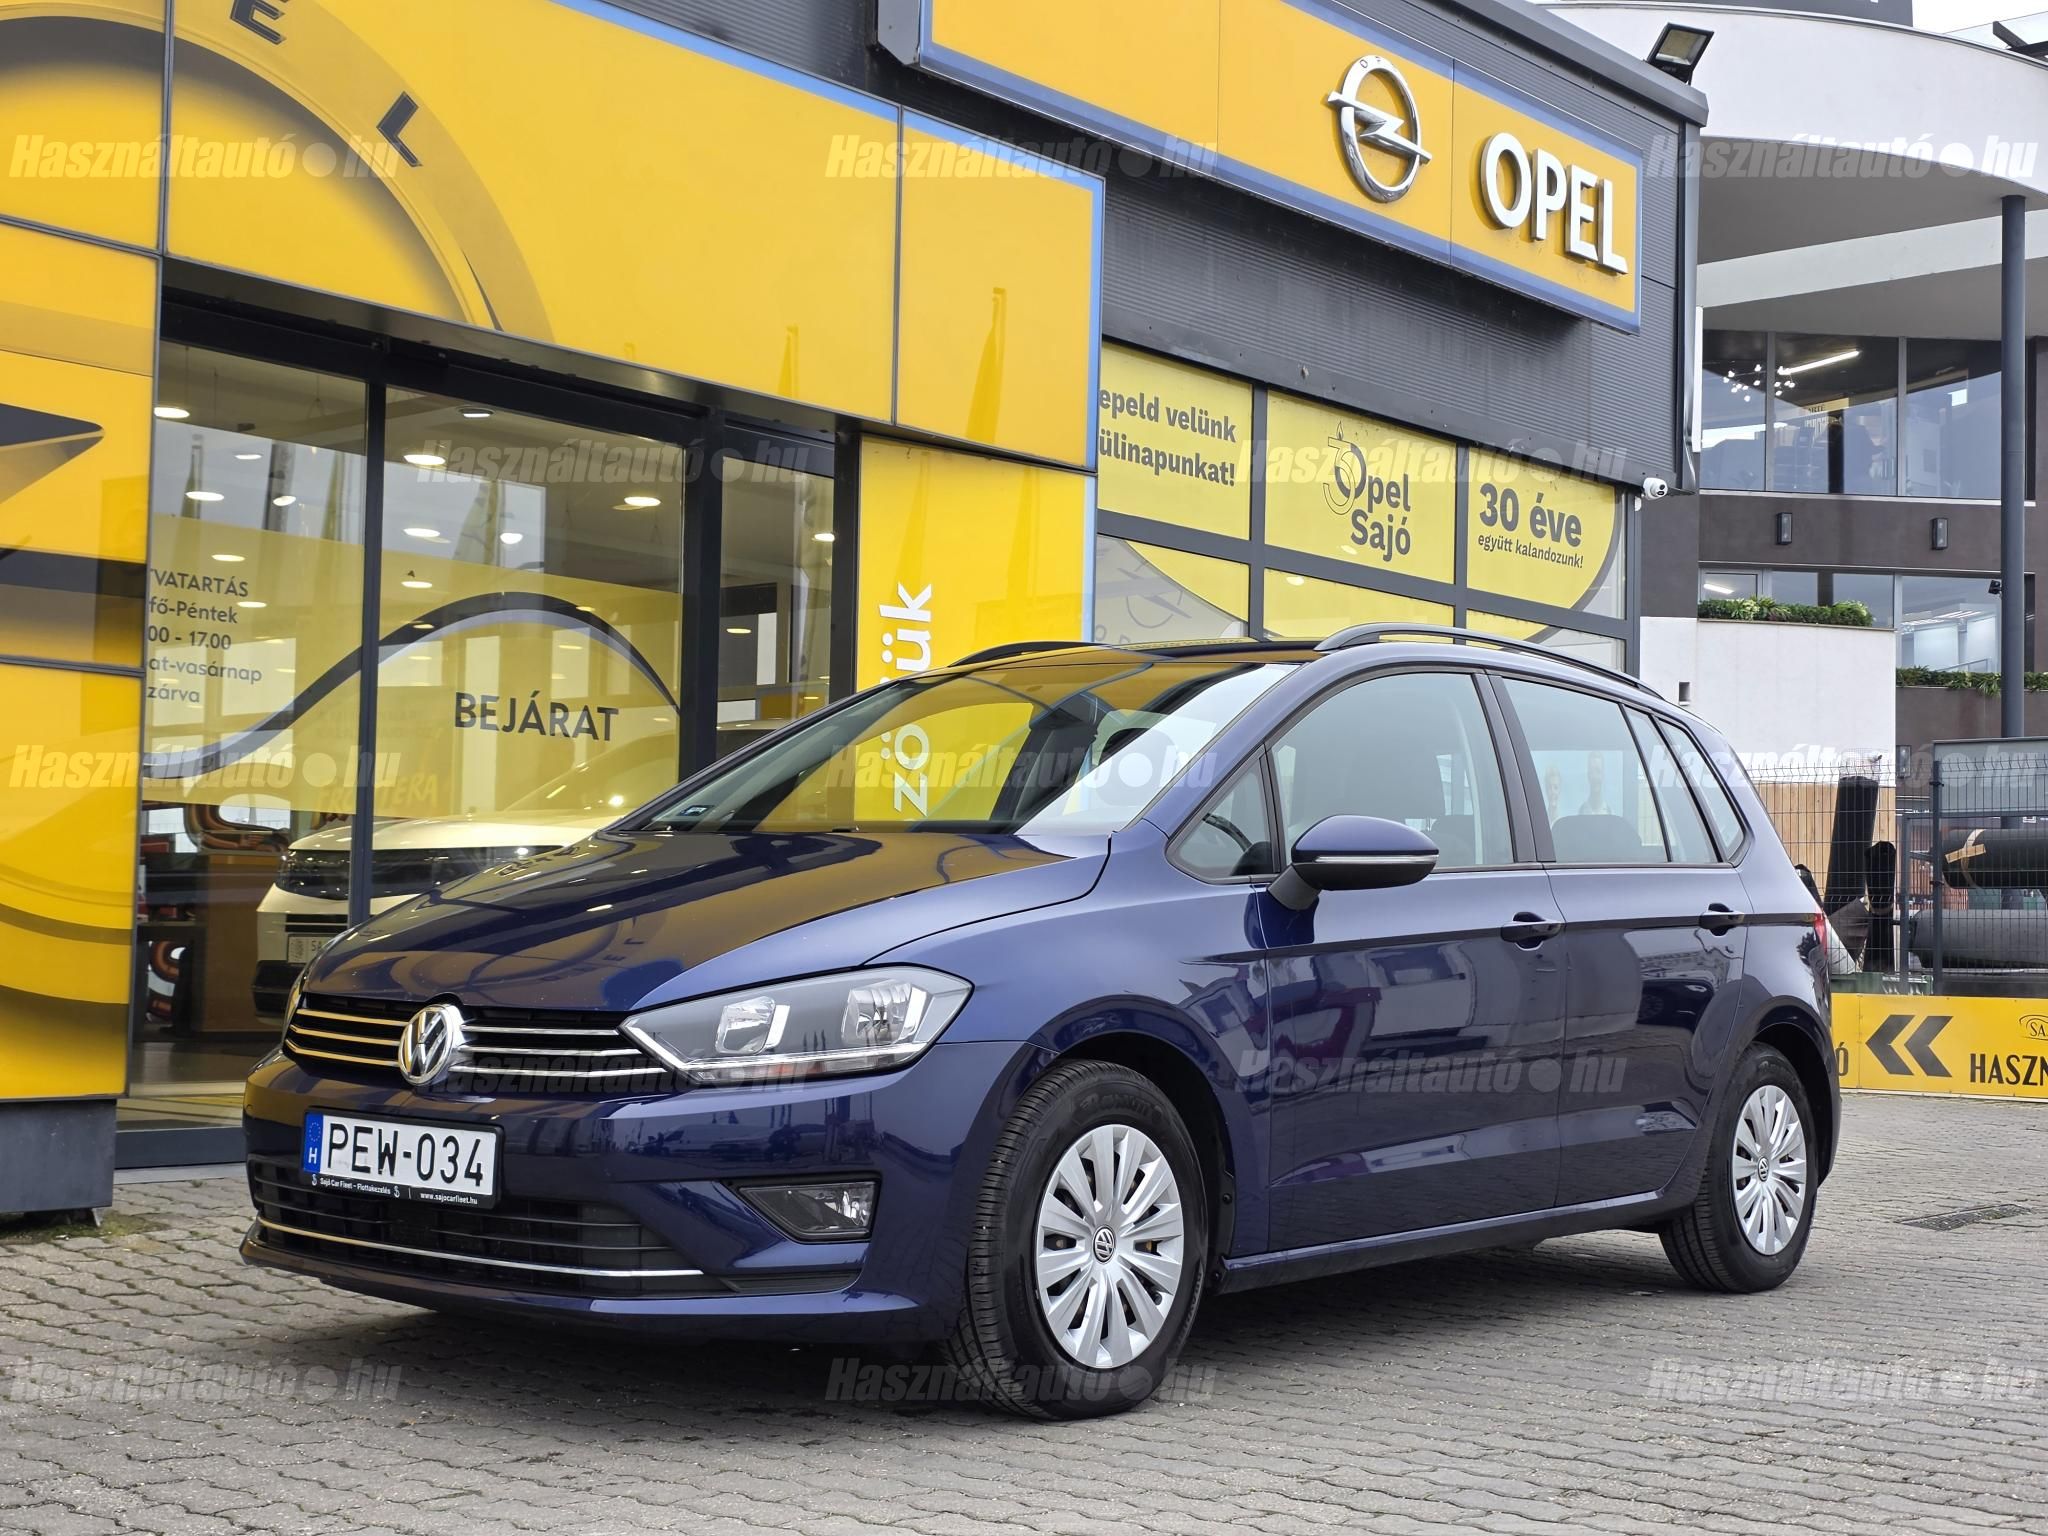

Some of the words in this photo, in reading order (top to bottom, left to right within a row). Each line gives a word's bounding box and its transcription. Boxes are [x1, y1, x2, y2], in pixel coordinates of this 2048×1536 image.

[1481, 133, 1629, 275] OPEL
[1099, 388, 1160, 423] epeld
[1165, 406, 1237, 443] velünk
[1099, 428, 1236, 487] ülinapunkat!
[1334, 442, 1411, 514] Opel
[1350, 508, 1411, 562] Sajó
[1479, 482, 1520, 532] 30
[1529, 492, 1582, 548] éve
[1477, 534, 1513, 553] együtt
[1515, 539, 1584, 569] kalandozunk!
[190, 631, 232, 650] 17.00
[147, 683, 200, 703] zárva
[149, 657, 263, 685] at-vasárnap
[455, 690, 619, 742] BEJÁRAT
[307, 1147, 318, 1165] H
[327, 1122, 483, 1187] PEW-034
